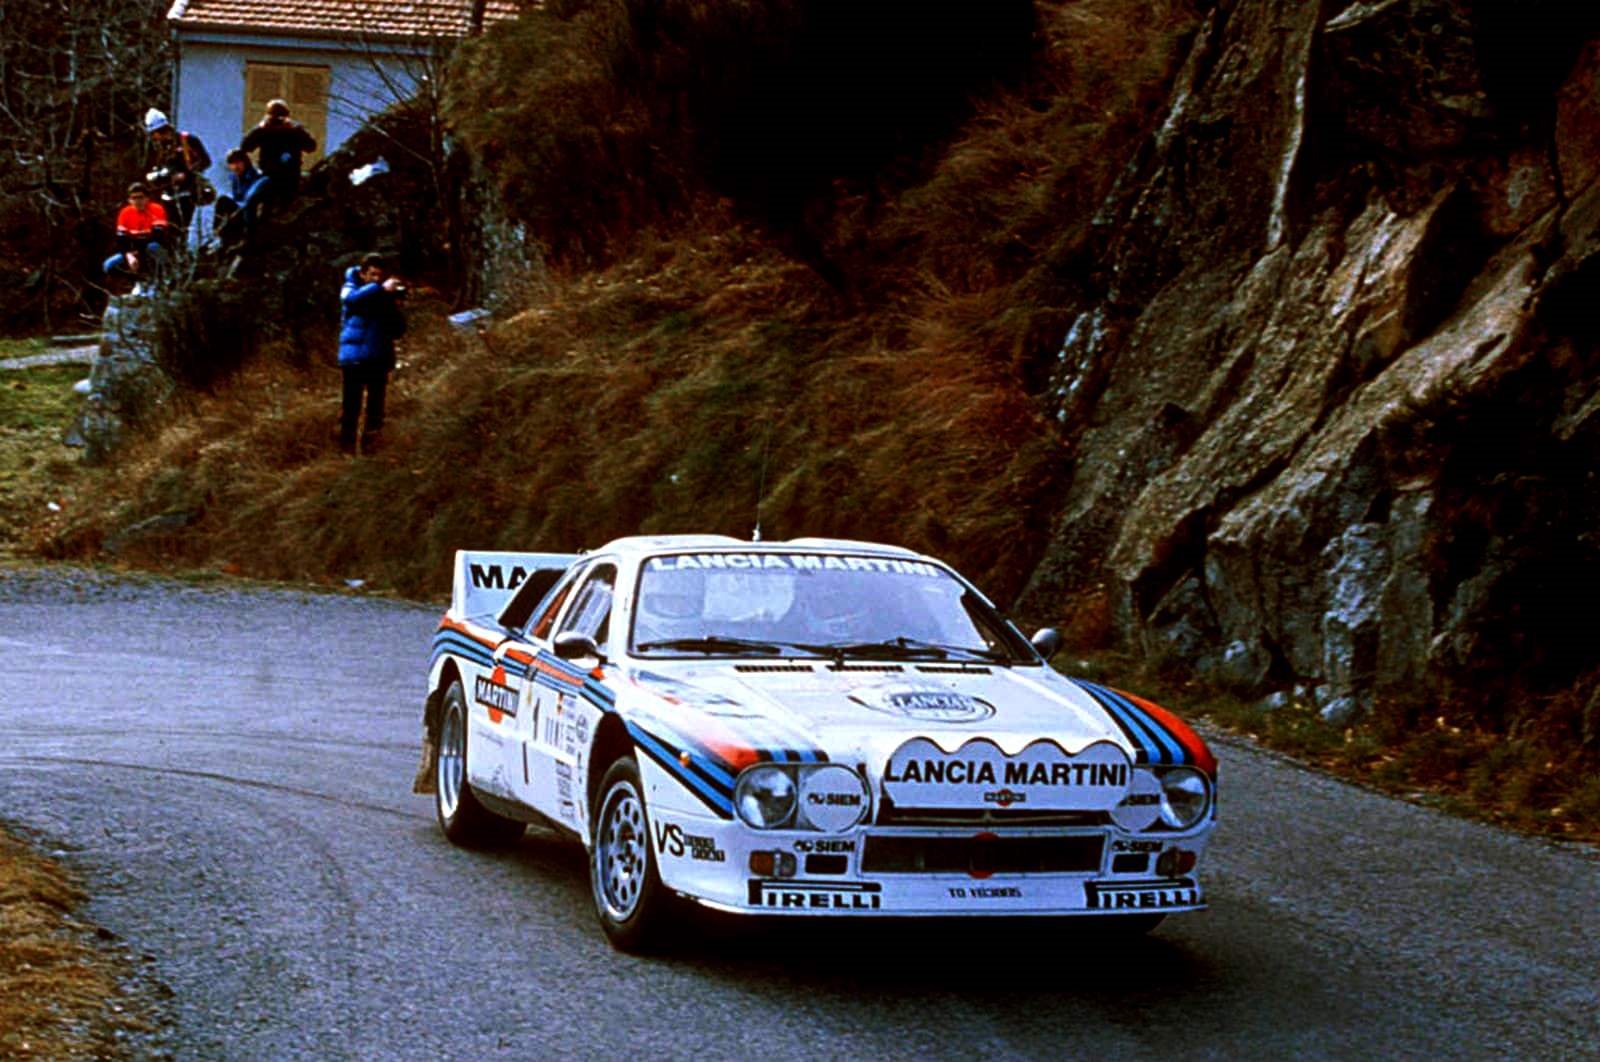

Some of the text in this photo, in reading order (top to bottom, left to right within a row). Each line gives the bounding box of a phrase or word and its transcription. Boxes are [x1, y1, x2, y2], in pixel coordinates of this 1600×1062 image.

[651, 554, 939, 577] LANCIA MARTINI
[884, 759, 1127, 787] LANCIA MARTINI
[655, 819, 685, 857] VS
[748, 879, 881, 909] PIRELLI
[1084, 878, 1197, 909] PIRELLI
